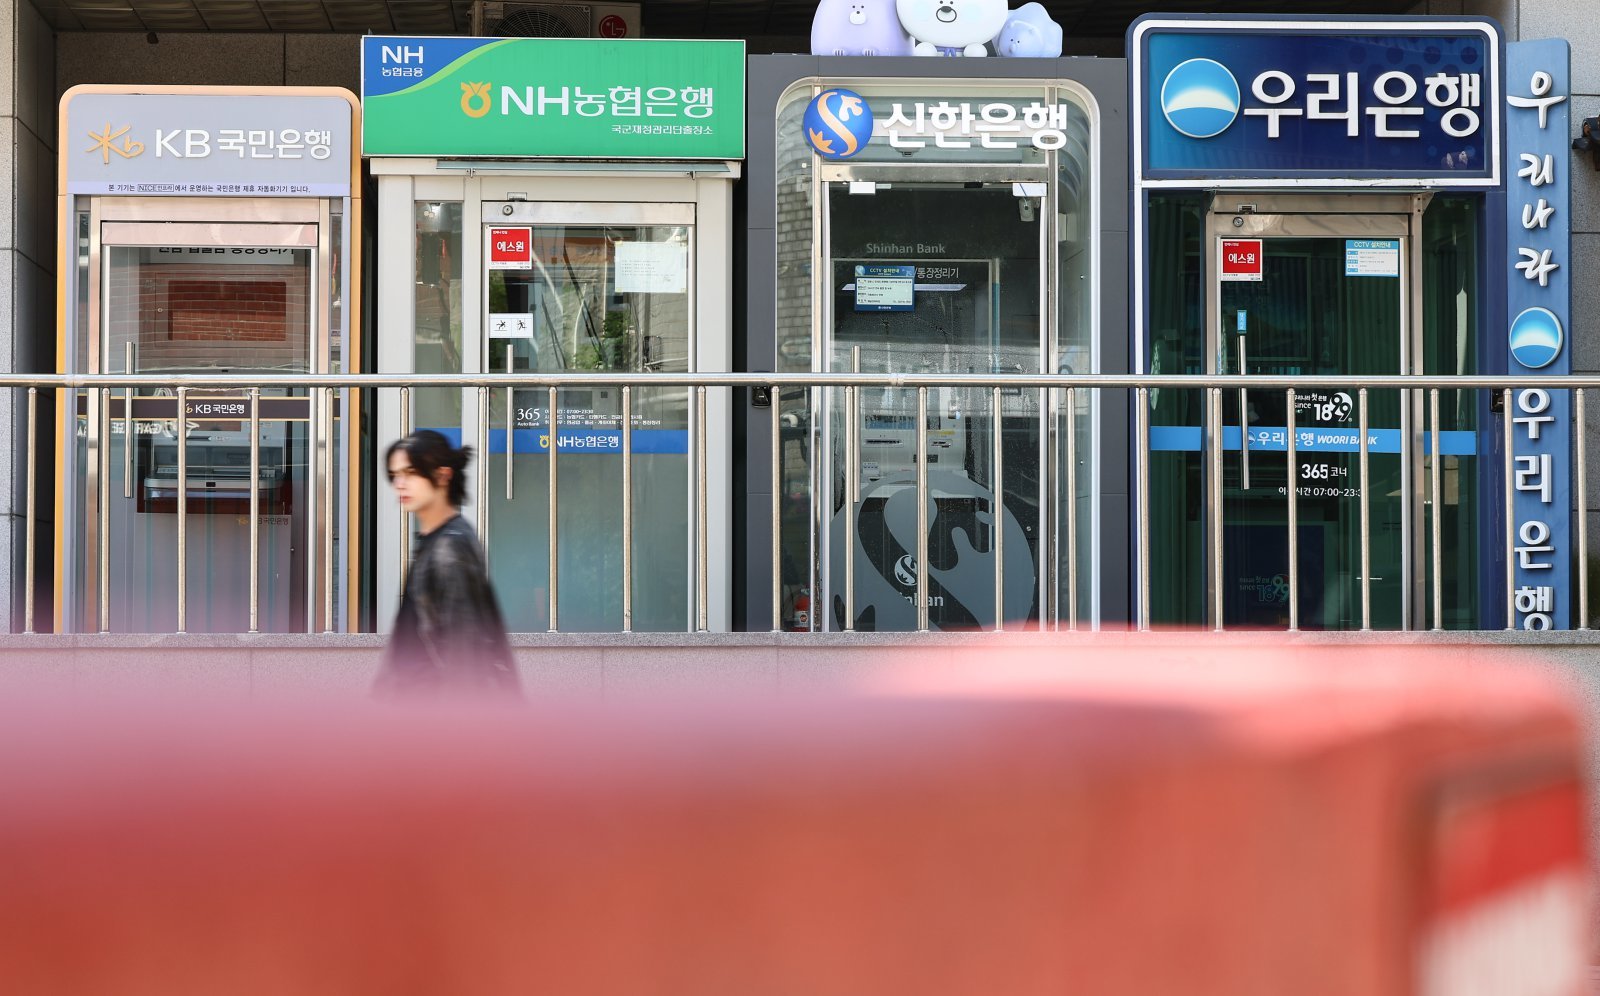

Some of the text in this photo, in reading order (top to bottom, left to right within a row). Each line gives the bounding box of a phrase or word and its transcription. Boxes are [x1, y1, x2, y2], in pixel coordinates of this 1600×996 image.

[381, 45, 424, 64] NH
[381, 66, 424, 78] 농협금융
[500, 85, 714, 119] NH농협은행
[1243, 70, 1481, 139] 우리은행
[611, 124, 714, 136] 국군재정관리단출장소
[882, 101, 1067, 150] 신한은행
[155, 129, 211, 158] KB
[217, 128, 332, 160] 국민은행
[108, 184, 115, 192] 본
[117, 184, 136, 192] 기기는
[189, 184, 213, 193] 운영하는
[216, 184, 241, 193] 국민은행
[257, 185, 288, 193] 자동화기기
[496, 241, 524, 252] 에스원
[866, 243, 946, 254] Shinhan Bank
[1228, 253, 1255, 264] 에스원
[195, 404, 245, 414] KB 국민은행
[516, 408, 541, 421] 365
[1257, 431, 1314, 447] 우리행
[1317, 434, 1349, 444] WOORI
[1301, 464, 1347, 479] 365 코너
[1278, 487, 1311, 497] 이시간
[1512, 388, 1555, 630] 우리은행
